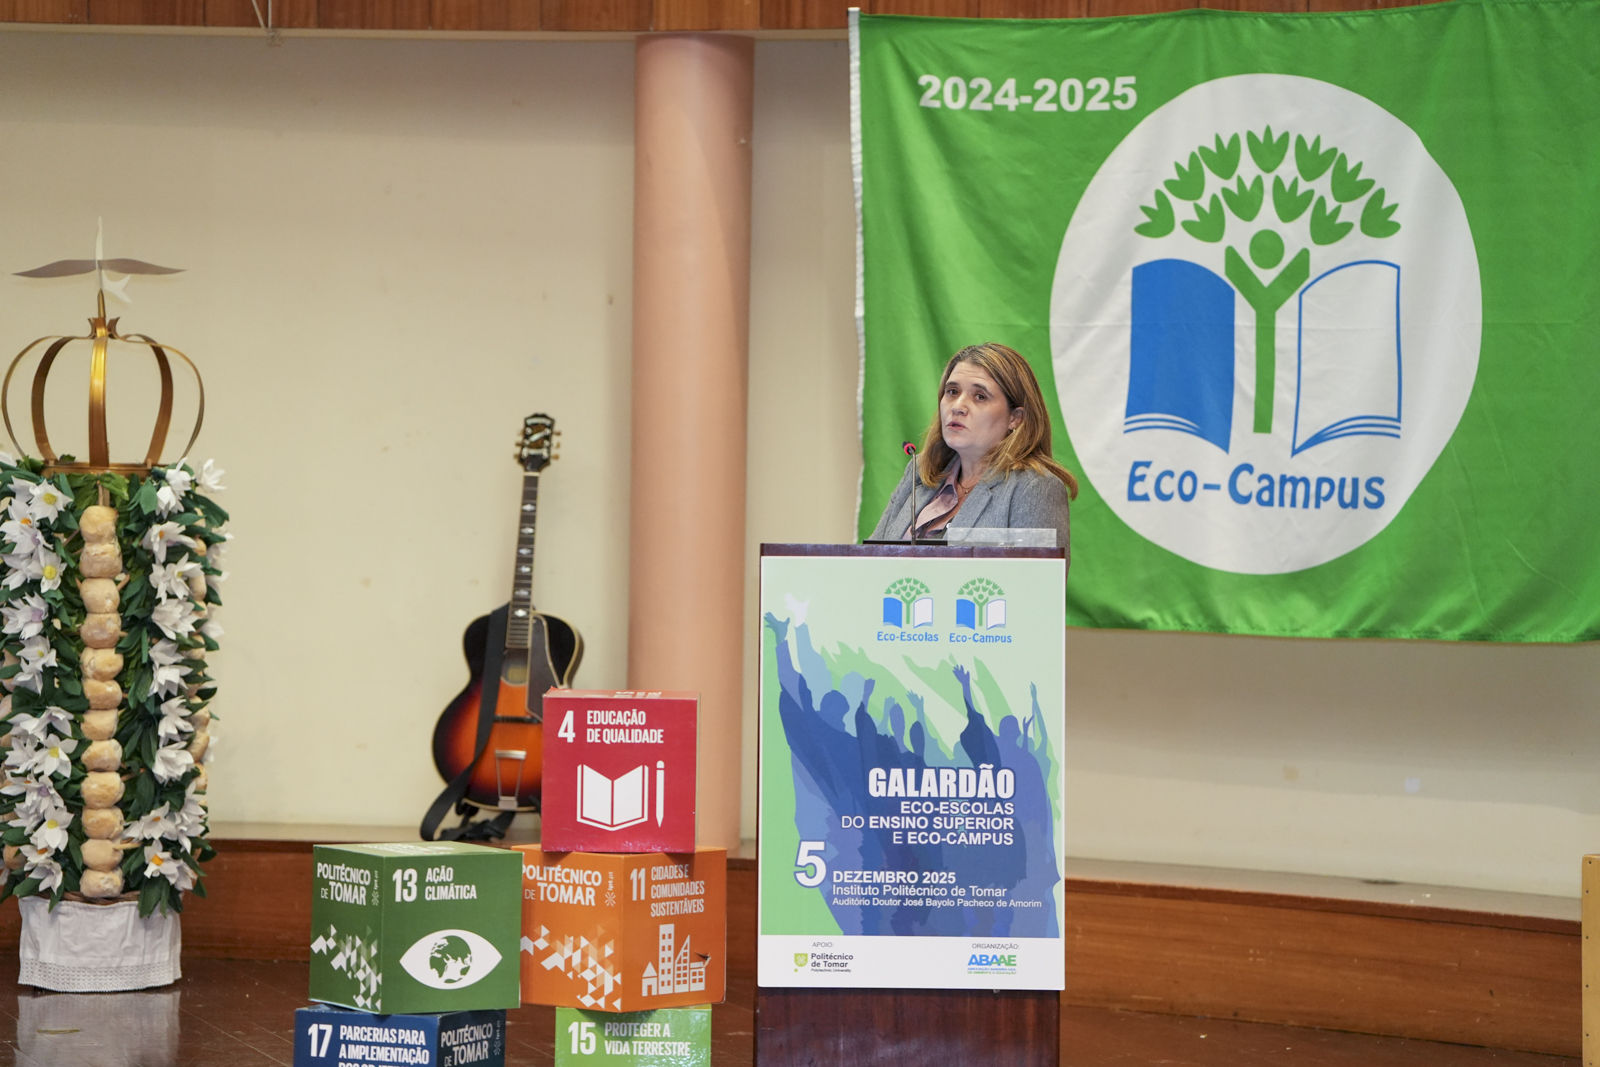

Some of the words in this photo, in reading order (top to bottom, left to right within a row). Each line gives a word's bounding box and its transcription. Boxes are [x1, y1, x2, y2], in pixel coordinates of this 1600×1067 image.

[917, 73, 1138, 113] 2024-2025
[1127, 460, 1387, 511] Eco-Campus
[877, 631, 939, 642] Eco-Escolas
[949, 632, 1012, 643] Eco-Campus
[557, 710, 576, 743] 4
[586, 708, 646, 727] EDUCAÇÃO
[586, 728, 601, 743] DE
[602, 728, 664, 745] QUALIDADE
[868, 763, 1015, 799] GALARDÃO
[900, 801, 1015, 815] ECO-ESCOLAS
[841, 815, 865, 829] DO
[869, 816, 929, 829] ENSINO
[933, 816, 1015, 830] SUPERIOR
[893, 831, 903, 844] E
[907, 831, 1014, 846] ECO-CAMPUS
[651, 865, 683, 881] CIDADES
[684, 863, 690, 878] E
[794, 841, 827, 887] 5
[316, 862, 371, 886] POLITÉCNICO
[425, 865, 454, 884] AÇÃO
[833, 870, 919, 883] DEZEMBRO
[922, 871, 956, 884] 2025
[320, 887, 329, 899] DE
[329, 880, 367, 906] TOMAR
[392, 868, 418, 903] 13
[425, 883, 477, 901] CLIMÁTICA
[524, 888, 536, 900] DE
[537, 881, 596, 907] TOMAR
[629, 867, 646, 902] 11
[651, 880, 705, 900] COMUNIDADES
[832, 884, 880, 896] Instituto
[883, 884, 948, 897] Politécnico
[950, 885, 966, 896] de
[968, 886, 1007, 897] Tomar
[650, 896, 705, 918] SUSTENTÁVEIS
[832, 896, 870, 906] Auditório
[872, 897, 901, 907] Doutor
[903, 897, 924, 907] José
[925, 898, 955, 909] Bayolo
[957, 898, 995, 908] Pacheco
[996, 898, 1008, 908] de
[1009, 898, 1042, 909] Amorim
[811, 952, 854, 961] Politécnico
[811, 960, 821, 968] de
[967, 954, 1017, 966] ABAAE
[339, 1024, 397, 1044] PARCERIAS
[398, 1027, 426, 1046] PARA
[440, 1022, 494, 1048] POLITÉCNICO
[567, 1021, 596, 1055] 15
[604, 1022, 661, 1038] PROTEGER
[662, 1023, 671, 1038] A
[308, 1023, 333, 1058] 17
[604, 1040, 631, 1055] VIDA
[632, 1041, 691, 1056] TERRESTRE
[338, 1043, 347, 1059] A
[347, 1044, 430, 1065] IMPLEMENTAÇÃO
[444, 1055, 453, 1067] DE
[452, 1041, 489, 1066] TOMAR
